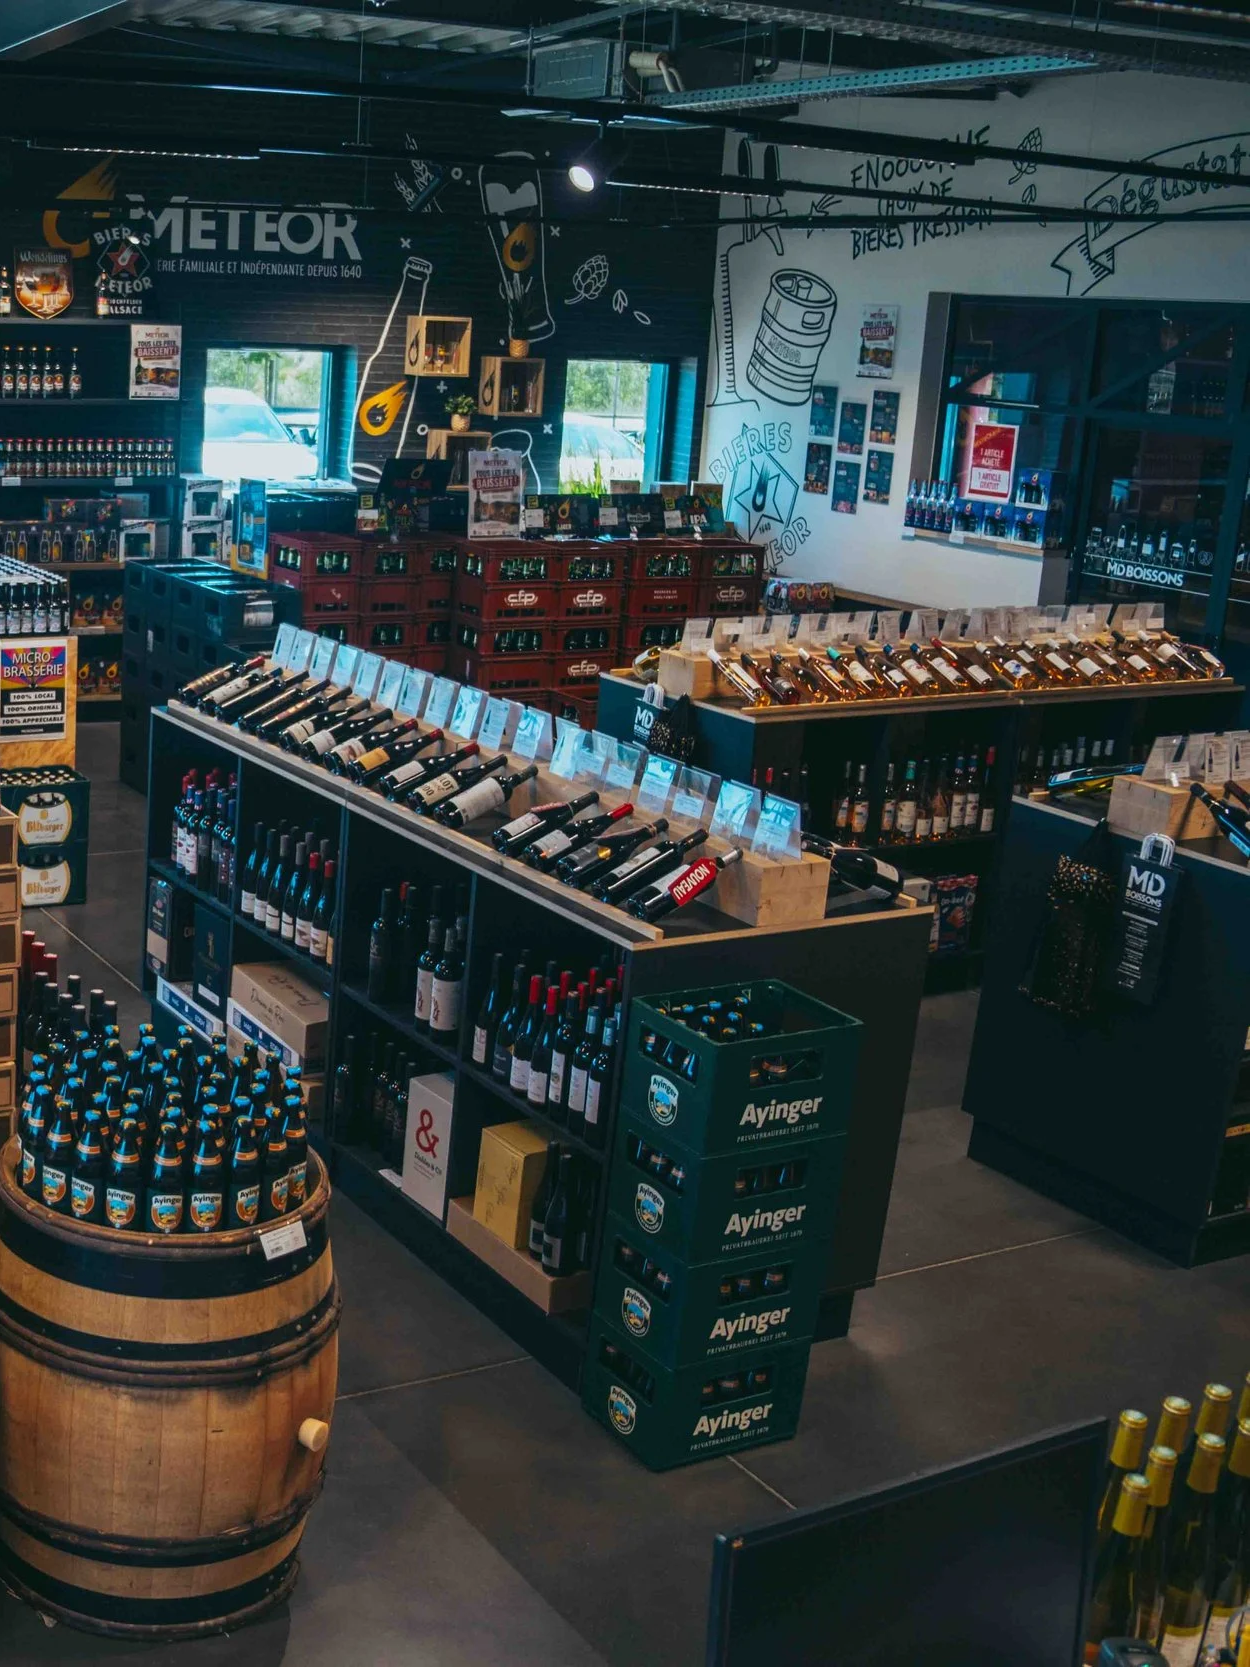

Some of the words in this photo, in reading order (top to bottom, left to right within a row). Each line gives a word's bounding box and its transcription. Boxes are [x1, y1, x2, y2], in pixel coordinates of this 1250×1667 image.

[93, 227, 152, 247] BIERS
[227, 261, 238, 274] ET
[307, 265, 338, 278] DEPUIS
[341, 265, 362, 279] 1640
[689, 514, 708, 524] IPA
[1107, 561, 1125, 576] MD
[1126, 566, 1184, 587] BOISSONS
[12, 652, 57, 664] MICRO-
[4, 664, 63, 678] BRASSERIE
[672, 863, 710, 901] NOUVEAU
[1127, 865, 1166, 897] MD
[1125, 888, 1162, 908] BOISSONS
[652, 1077, 677, 1098] Ayinger
[739, 1097, 823, 1128] Ayinger
[193, 1195, 221, 1203] Ayinger
[724, 1205, 806, 1237] Ayinger
[709, 1307, 791, 1341] Ayinger
[692, 1403, 773, 1436] Ayinger
